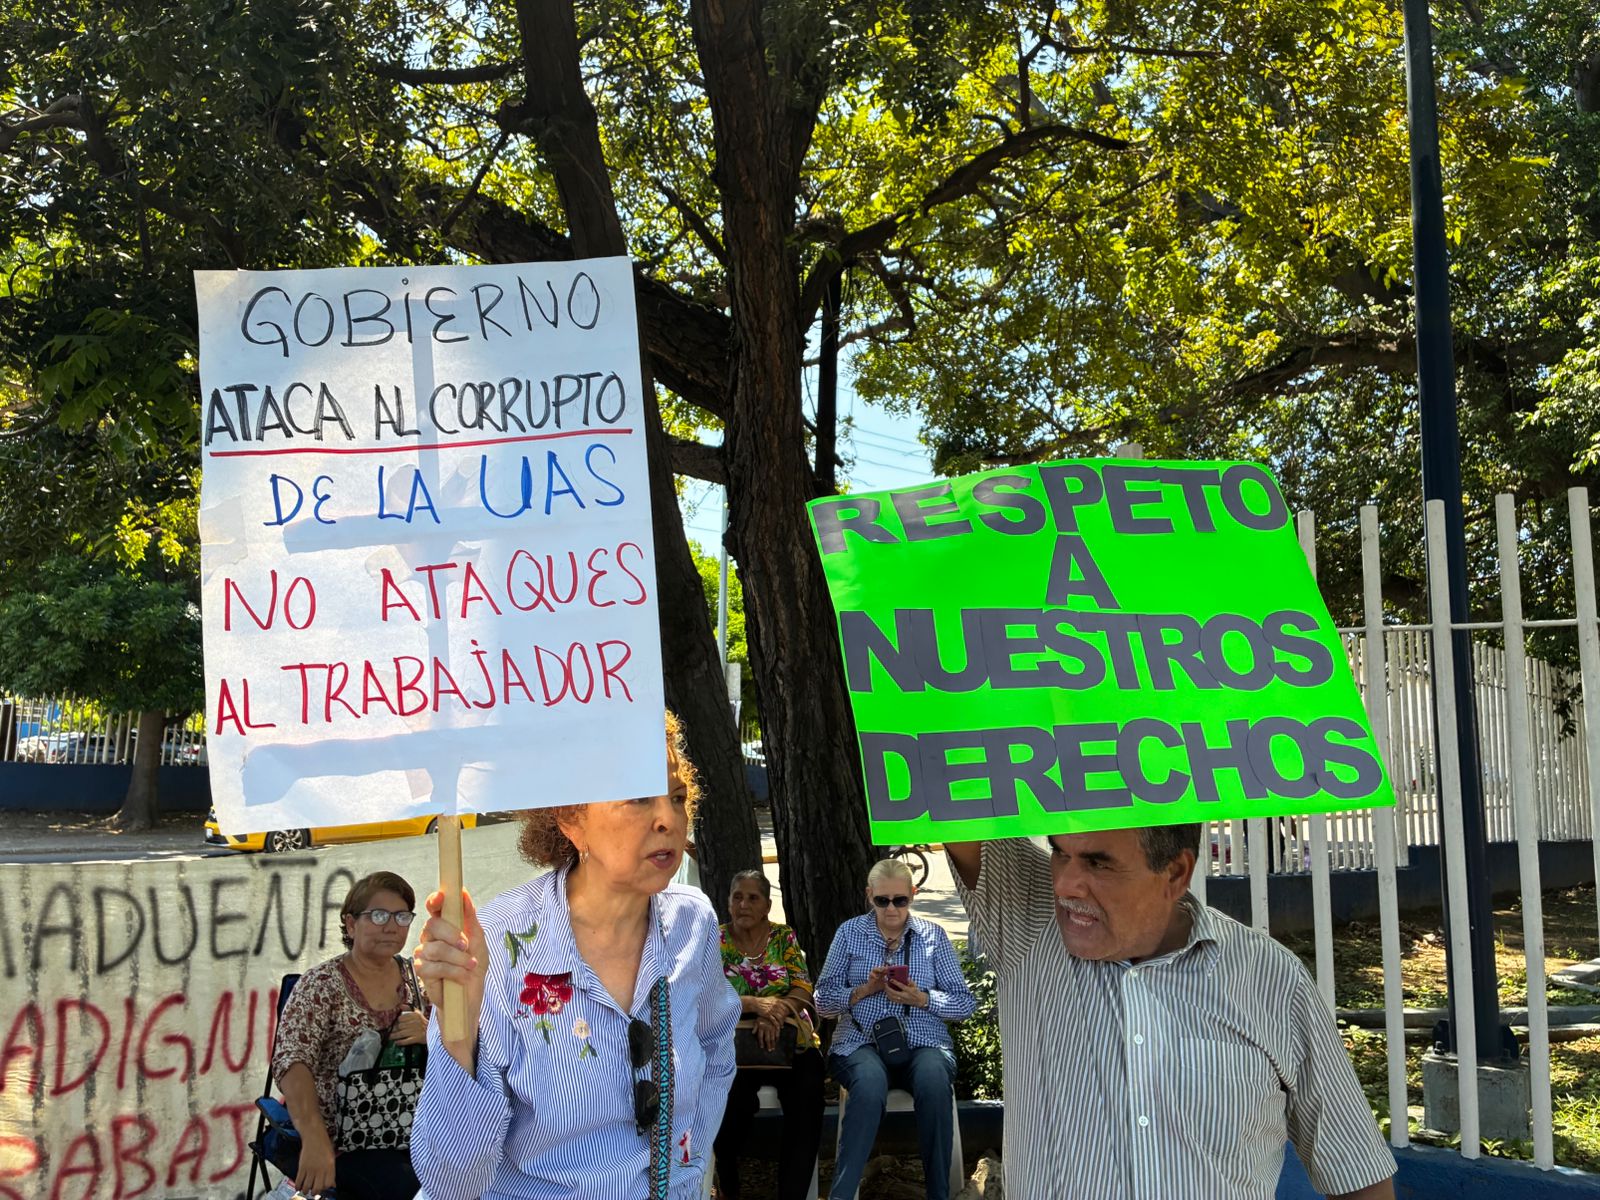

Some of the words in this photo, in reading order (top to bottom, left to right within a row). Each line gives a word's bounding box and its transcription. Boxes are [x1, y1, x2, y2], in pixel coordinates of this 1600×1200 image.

[205, 382, 355, 446] ATACA
[374, 384, 421, 441] AL
[428, 371, 626, 434] CORRUPTO
[264, 474, 336, 526] DE
[378, 465, 441, 523] LA
[480, 443, 626, 519] UAS
[813, 464, 1290, 555] RESPETO
[224, 569, 317, 631] NO
[381, 542, 647, 622] ATAQUES
[1045, 534, 1121, 609] A
[839, 607, 1335, 693] NUESTROS
[215, 678, 276, 735] AL
[859, 716, 1383, 822] DERECHOS
[0, 857, 356, 978] ADUEÑA
